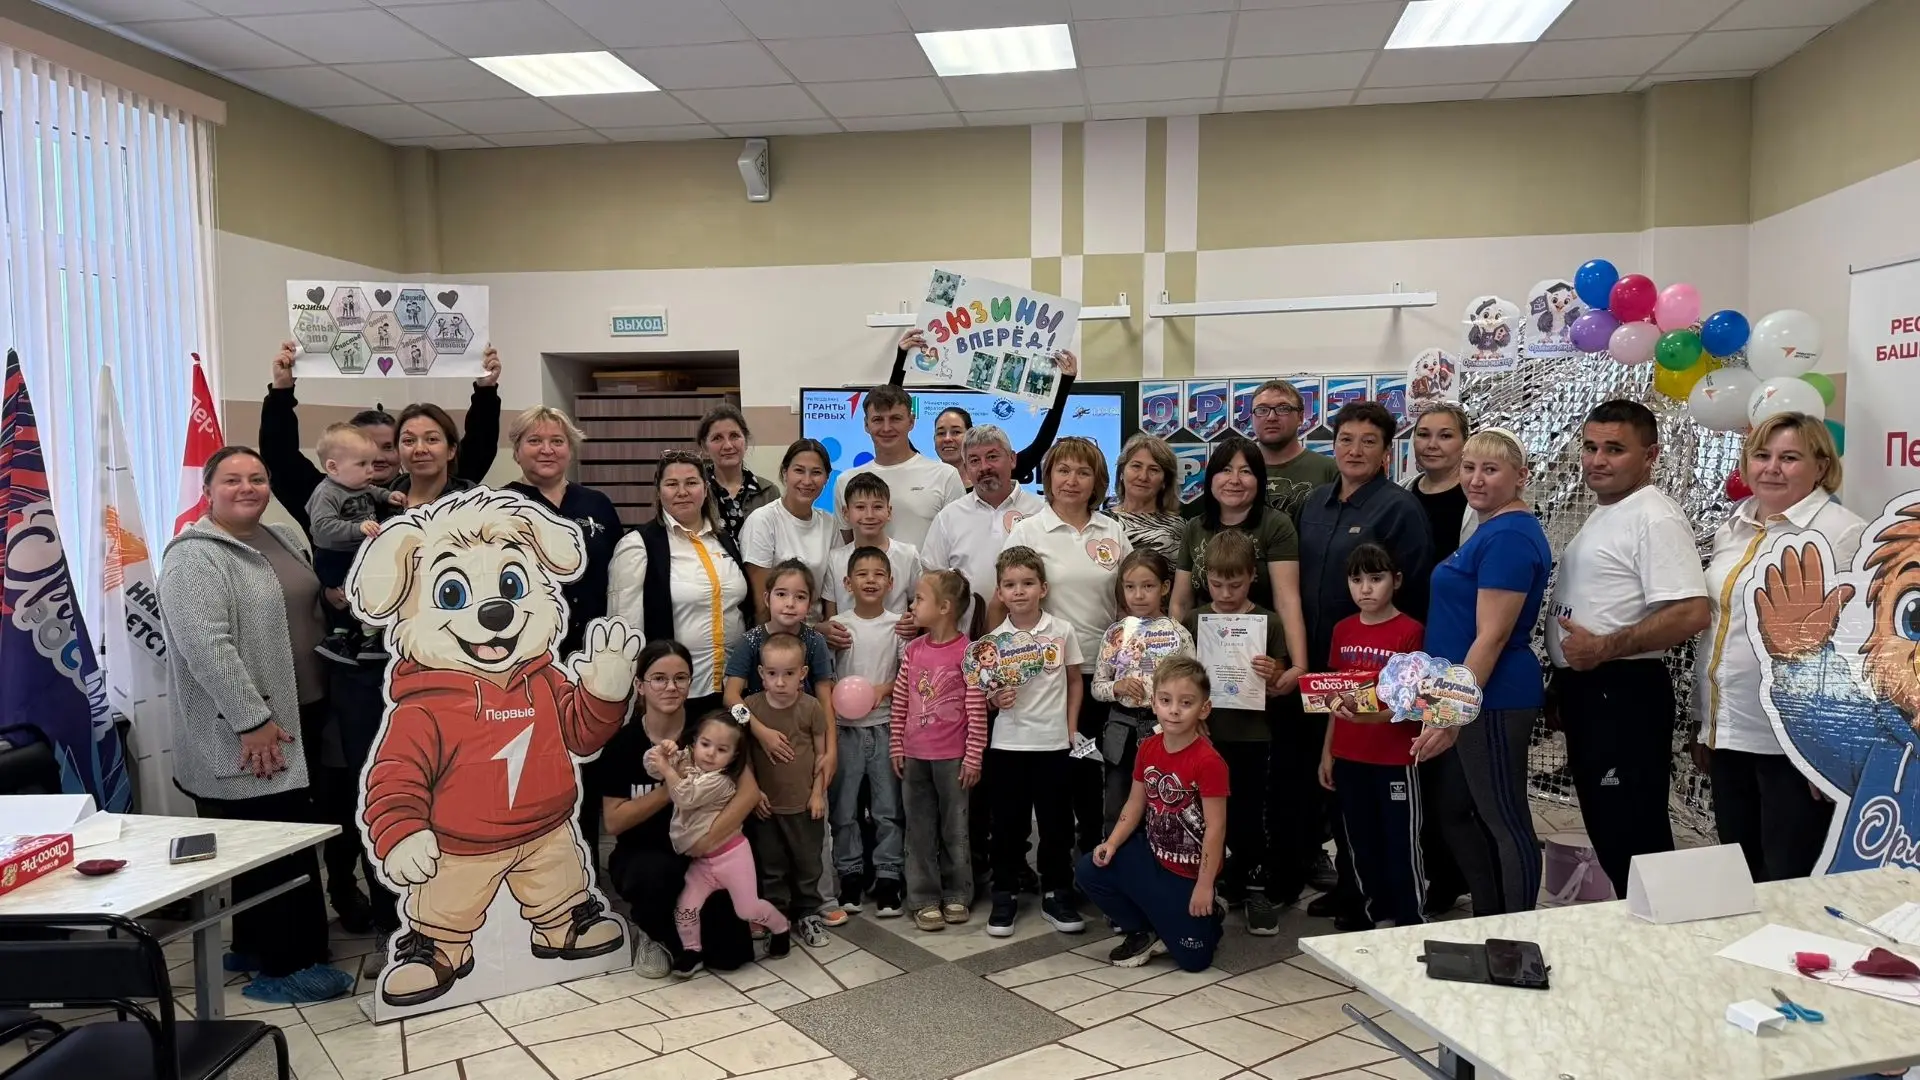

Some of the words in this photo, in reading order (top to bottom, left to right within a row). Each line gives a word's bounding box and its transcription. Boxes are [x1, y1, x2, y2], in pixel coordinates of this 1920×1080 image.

[298, 322, 334, 333] Семья
[616, 318, 662, 331] ВЫХОД
[928, 296, 1064, 343] ЗЮЗИНЫ
[956, 325, 1056, 354] ВПЕРЁД!
[1876, 341, 1920, 361] БАШ
[807, 403, 846, 411] ГРАНТЫ
[191, 395, 215, 440] Пер
[805, 412, 846, 420] ПЕРВЫХ
[1145, 630, 1175, 638] Любим
[999, 643, 1037, 658] Бережём
[1310, 679, 1360, 691] Choco-Pie
[1433, 677, 1476, 696] Дружим
[485, 708, 536, 727] Первые
[21, 841, 70, 872] Choco-Pie
